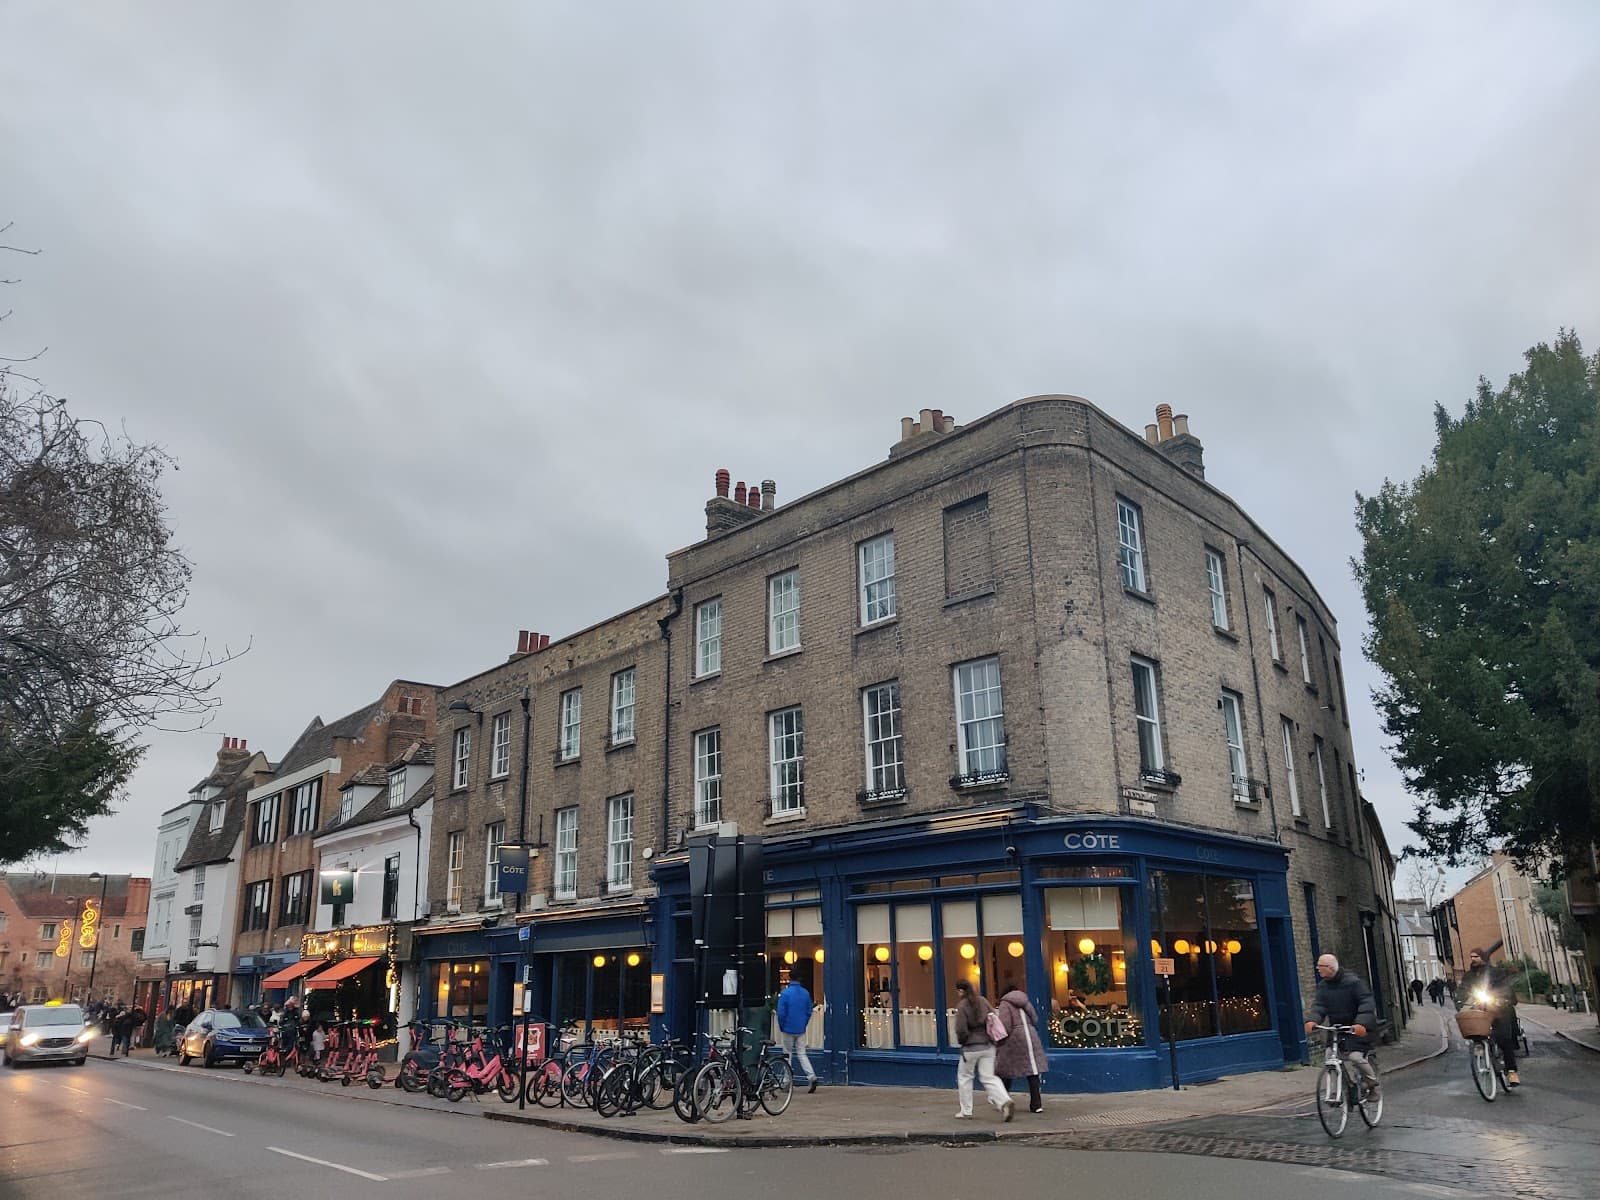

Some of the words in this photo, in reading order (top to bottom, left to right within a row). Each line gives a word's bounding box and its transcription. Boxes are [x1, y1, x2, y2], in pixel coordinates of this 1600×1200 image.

[1063, 831, 1121, 849] CÔTE
[502, 865, 525, 874] CÔTE
[1060, 1014, 1131, 1037] CÔTE
